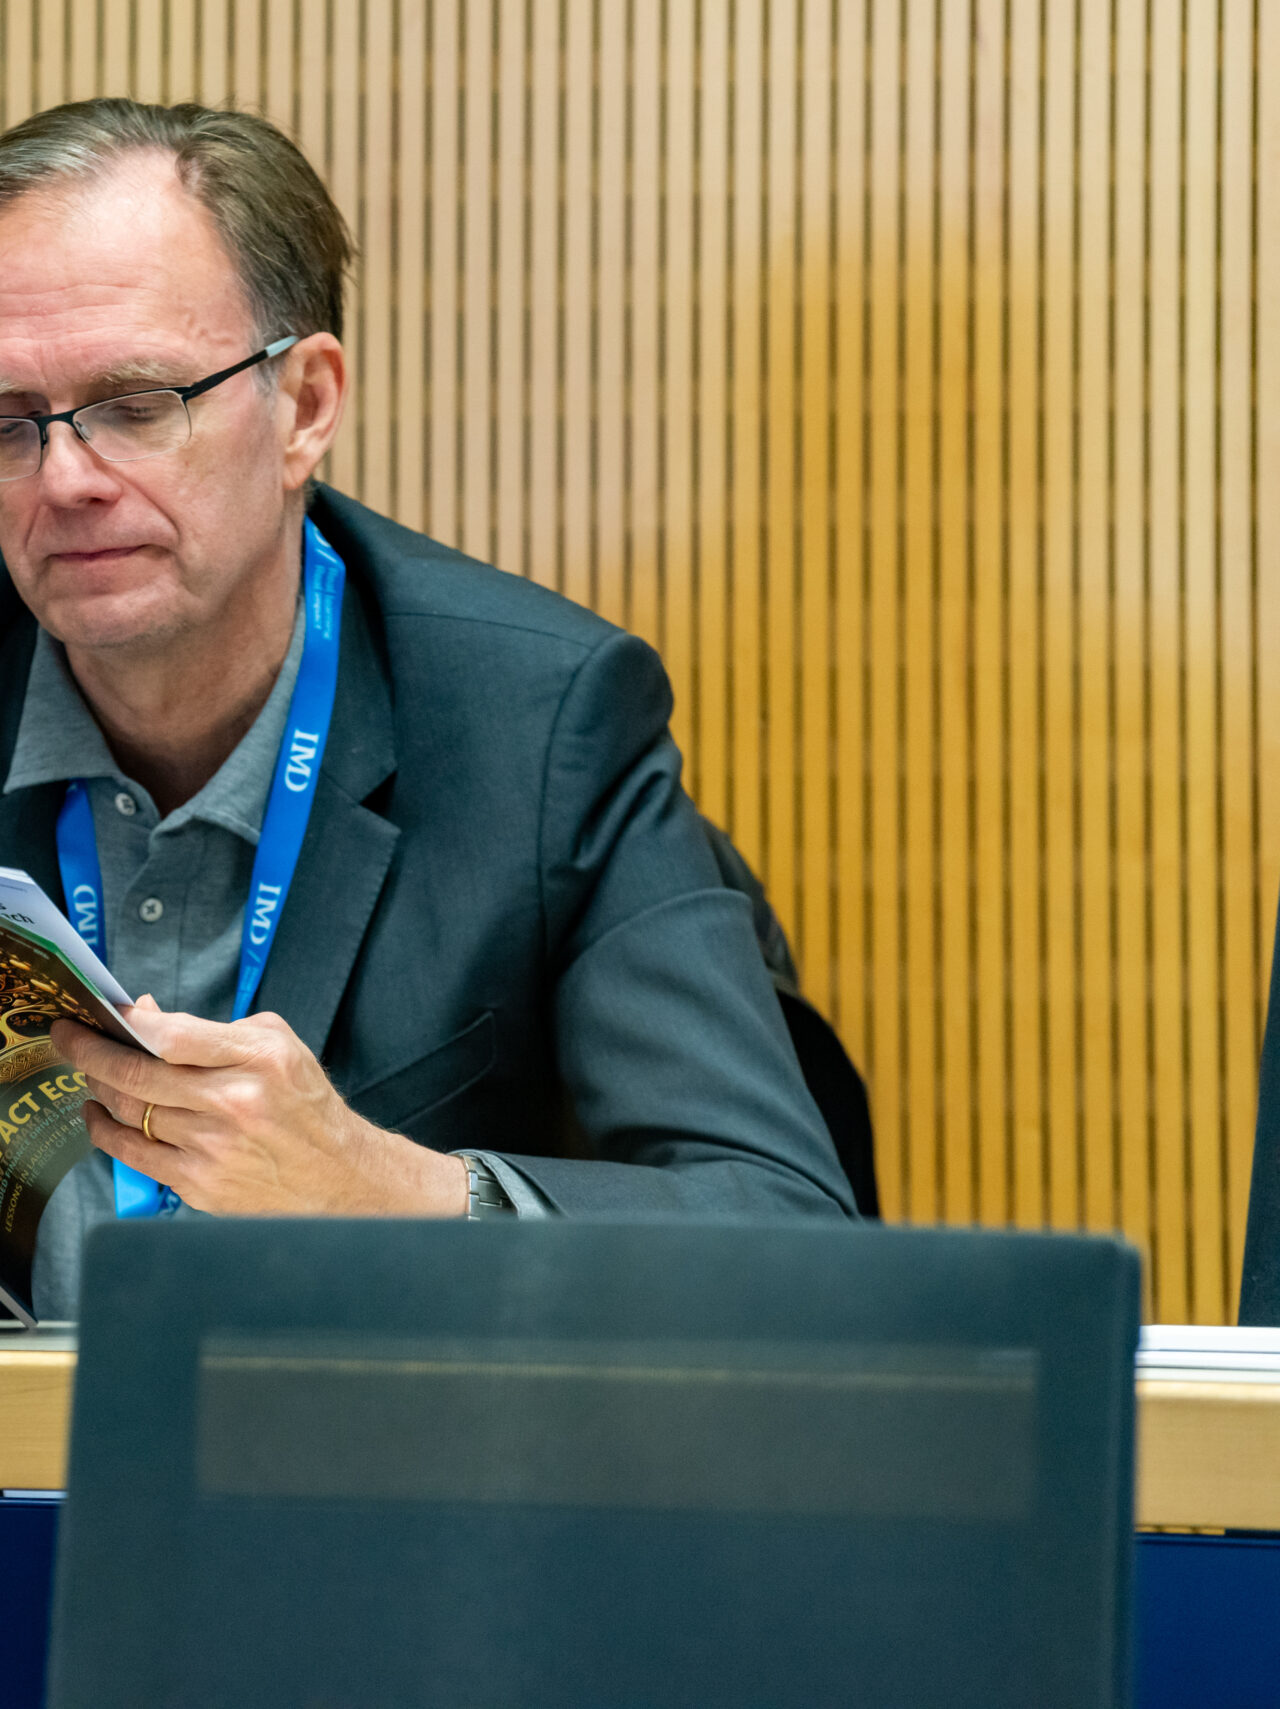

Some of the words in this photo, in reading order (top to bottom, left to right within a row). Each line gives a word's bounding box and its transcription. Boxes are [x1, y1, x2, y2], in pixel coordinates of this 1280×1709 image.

[284, 729, 320, 792] IMD
[249, 882, 282, 945] IMD
[38, 1071, 89, 1101] ECO
[0, 1148, 14, 1168] TO
[5, 1138, 32, 1179] FINANCE
[30, 1113, 60, 1140] DRIVES
[5, 1183, 24, 1233] LESSONS
[20, 1169, 30, 1183] IN
[27, 1125, 70, 1170] LAUGHTER
